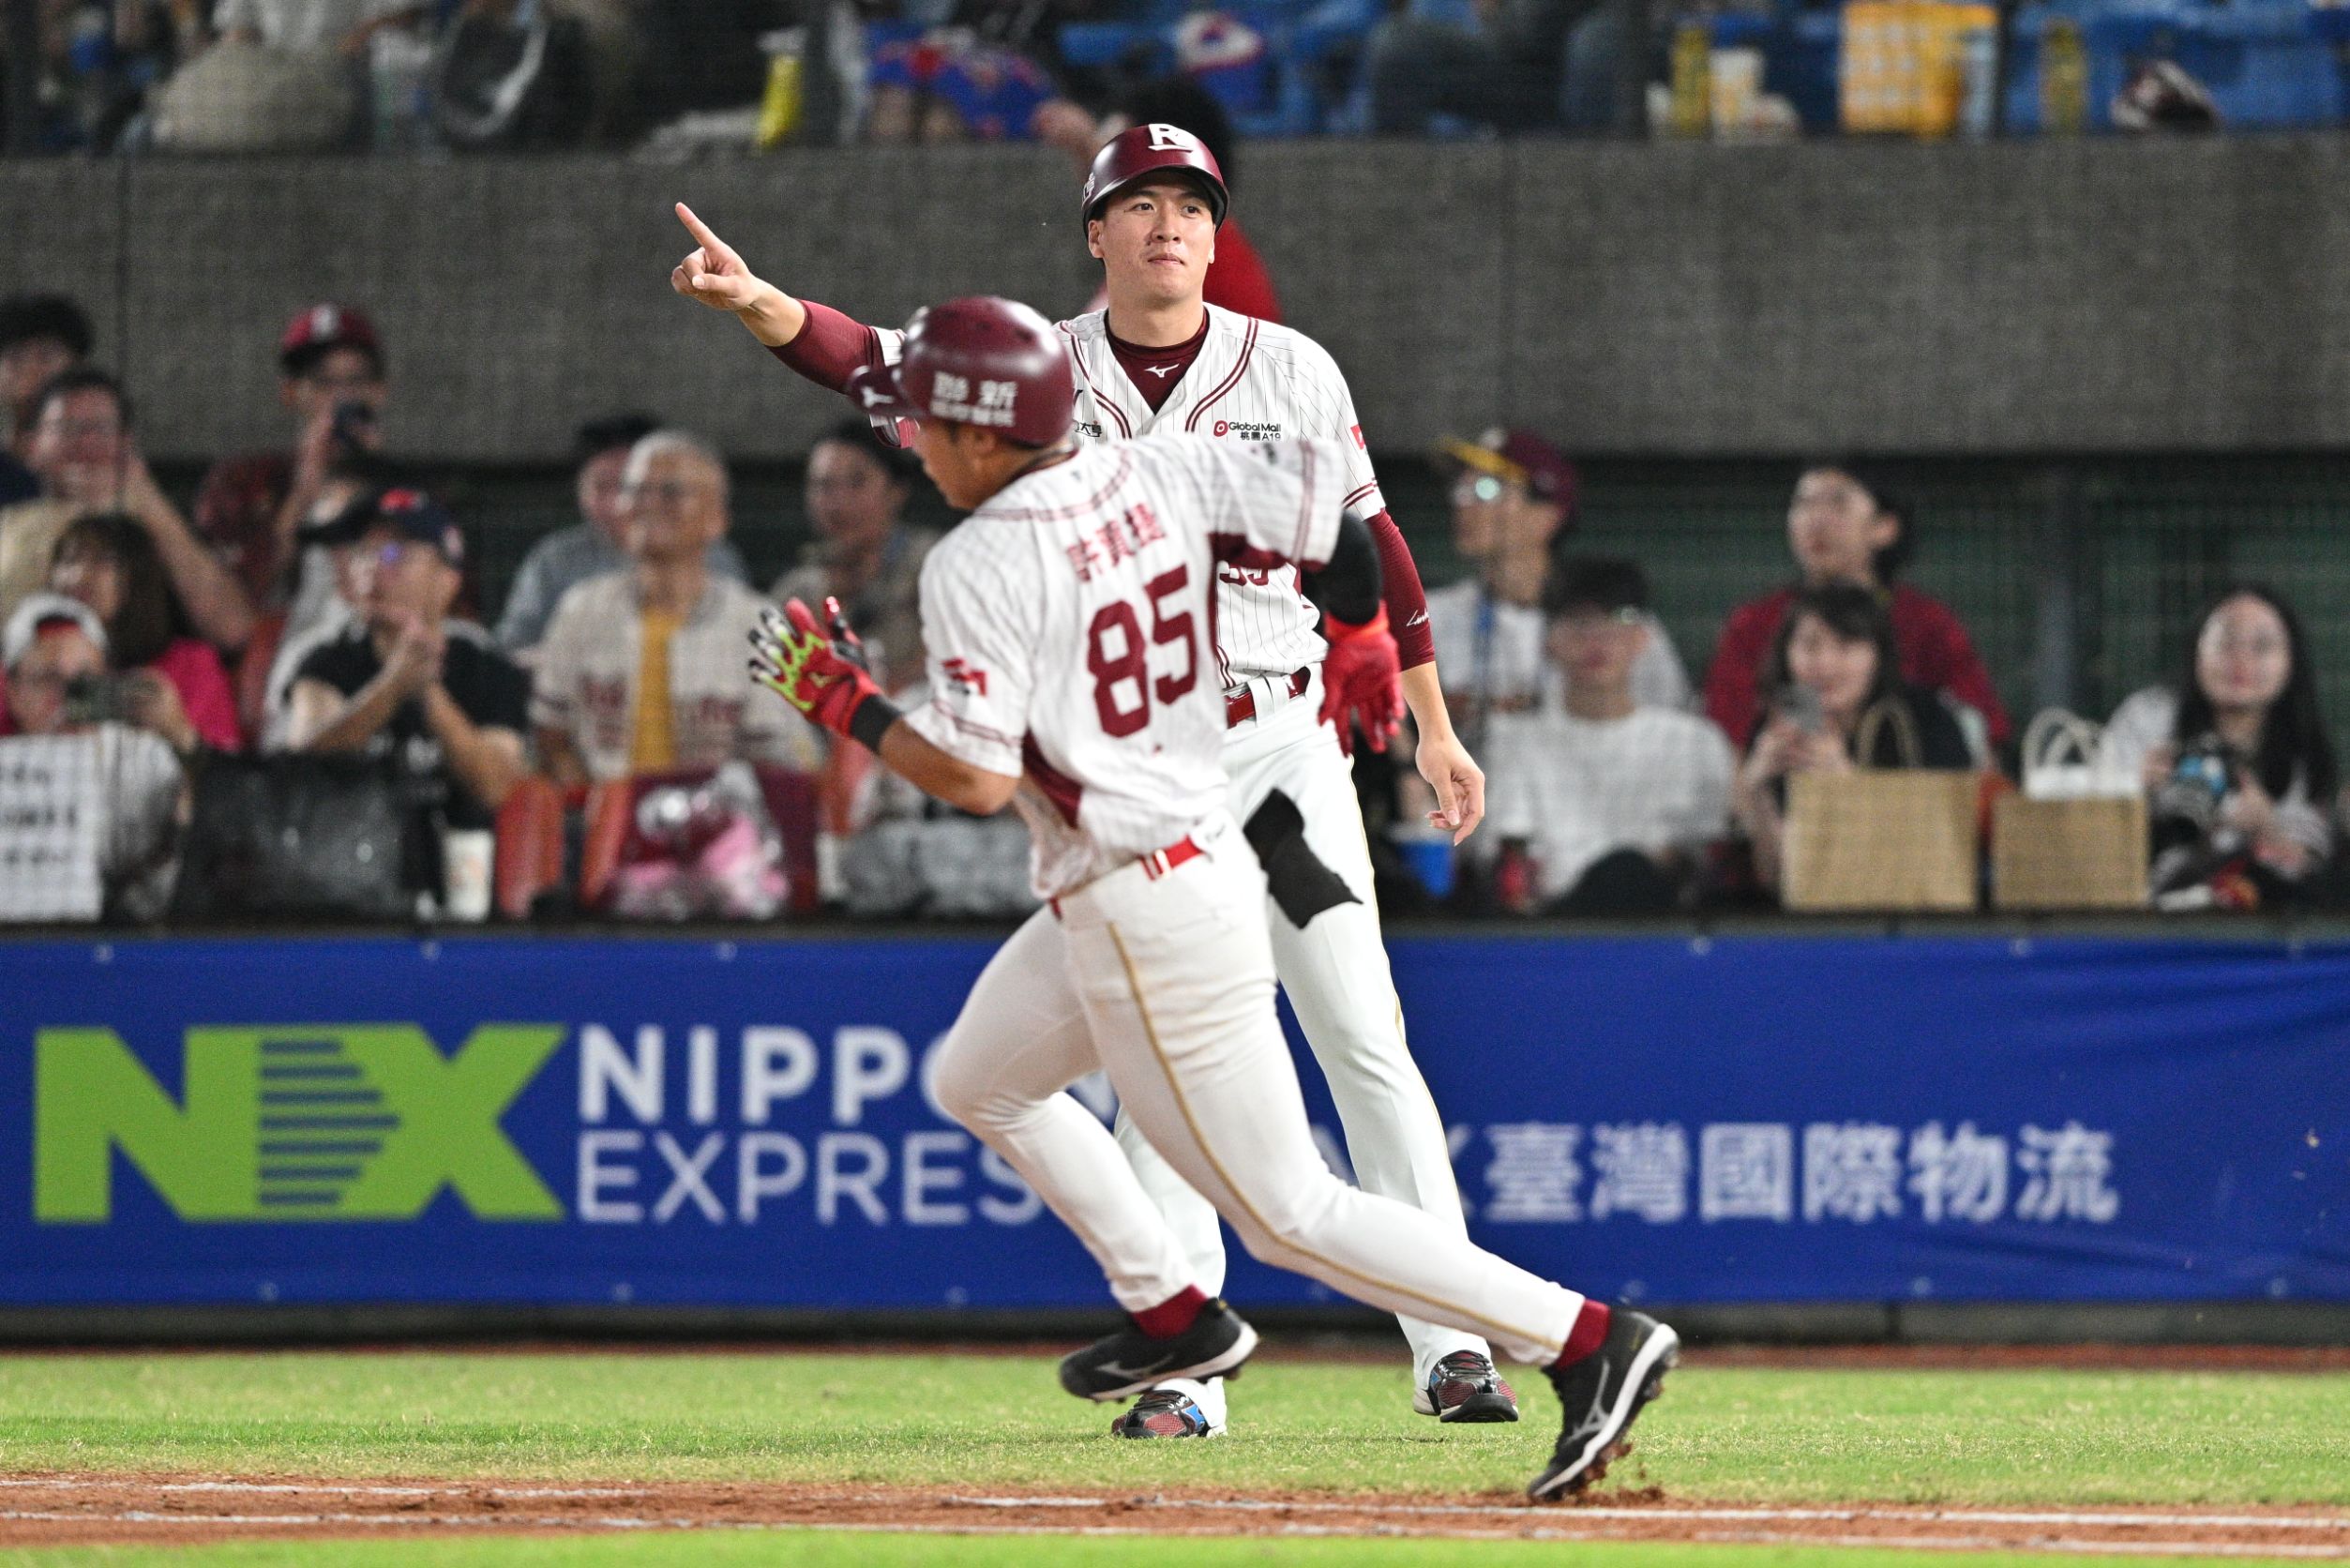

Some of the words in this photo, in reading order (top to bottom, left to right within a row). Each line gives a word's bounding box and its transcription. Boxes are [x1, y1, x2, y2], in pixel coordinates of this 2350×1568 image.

[1228, 421, 1260, 431] Global
[1087, 563, 1197, 738] 85
[579, 1026, 1122, 1123] NIPP
[35, 1024, 565, 1224] NX
[576, 1131, 1047, 1224] EXPRES
